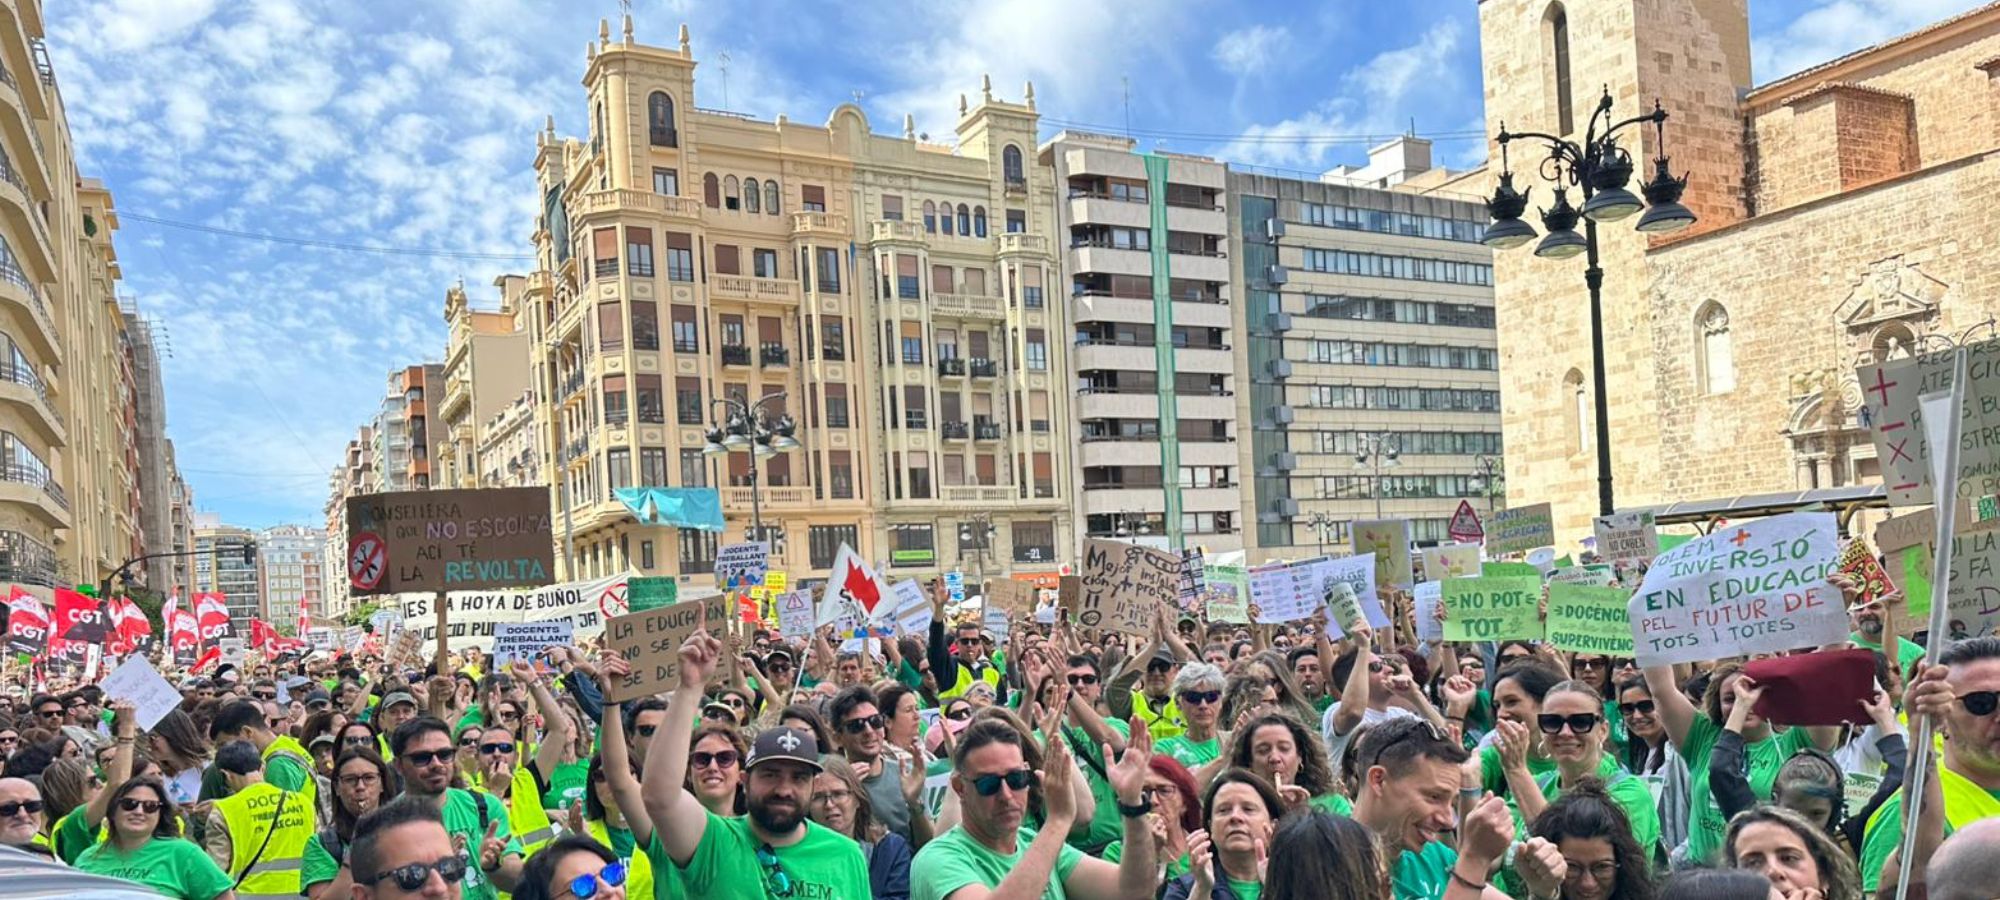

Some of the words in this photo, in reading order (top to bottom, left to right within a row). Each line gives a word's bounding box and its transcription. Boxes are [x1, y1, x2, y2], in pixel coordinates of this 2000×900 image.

[426, 521, 458, 540] NO
[465, 514, 550, 538] ESCOLTA
[1974, 531, 1996, 552] LA
[1669, 528, 1817, 578] INVERSIÓ
[401, 565, 424, 582] LA
[445, 558, 546, 583] REVOLTA
[1645, 587, 1684, 612] EN
[1709, 557, 1840, 605] EDUCACIÓ
[403, 597, 428, 619] IES
[461, 594, 506, 611] HOYA
[513, 595, 534, 611] DE
[537, 588, 588, 609] BUÑOL
[1459, 592, 1484, 608] NO
[1491, 590, 1524, 608] POT
[69, 608, 102, 624] CGT
[578, 611, 598, 629] JA
[1641, 616, 1677, 634] PEL
[1692, 597, 1768, 627] FUTUR
[1784, 586, 1824, 614] DE
[12, 622, 45, 641] CGT
[202, 623, 230, 639] CGT
[507, 626, 560, 634] DOCENTS
[615, 622, 633, 640] LA
[1461, 617, 1504, 637] TOT
[1650, 633, 1699, 652] TOTS
[1728, 617, 1795, 641] TOTES
[496, 635, 570, 643] TREBALLANT
[621, 645, 640, 660] NO
[651, 639, 670, 654] SE
[622, 670, 643, 688] SE
